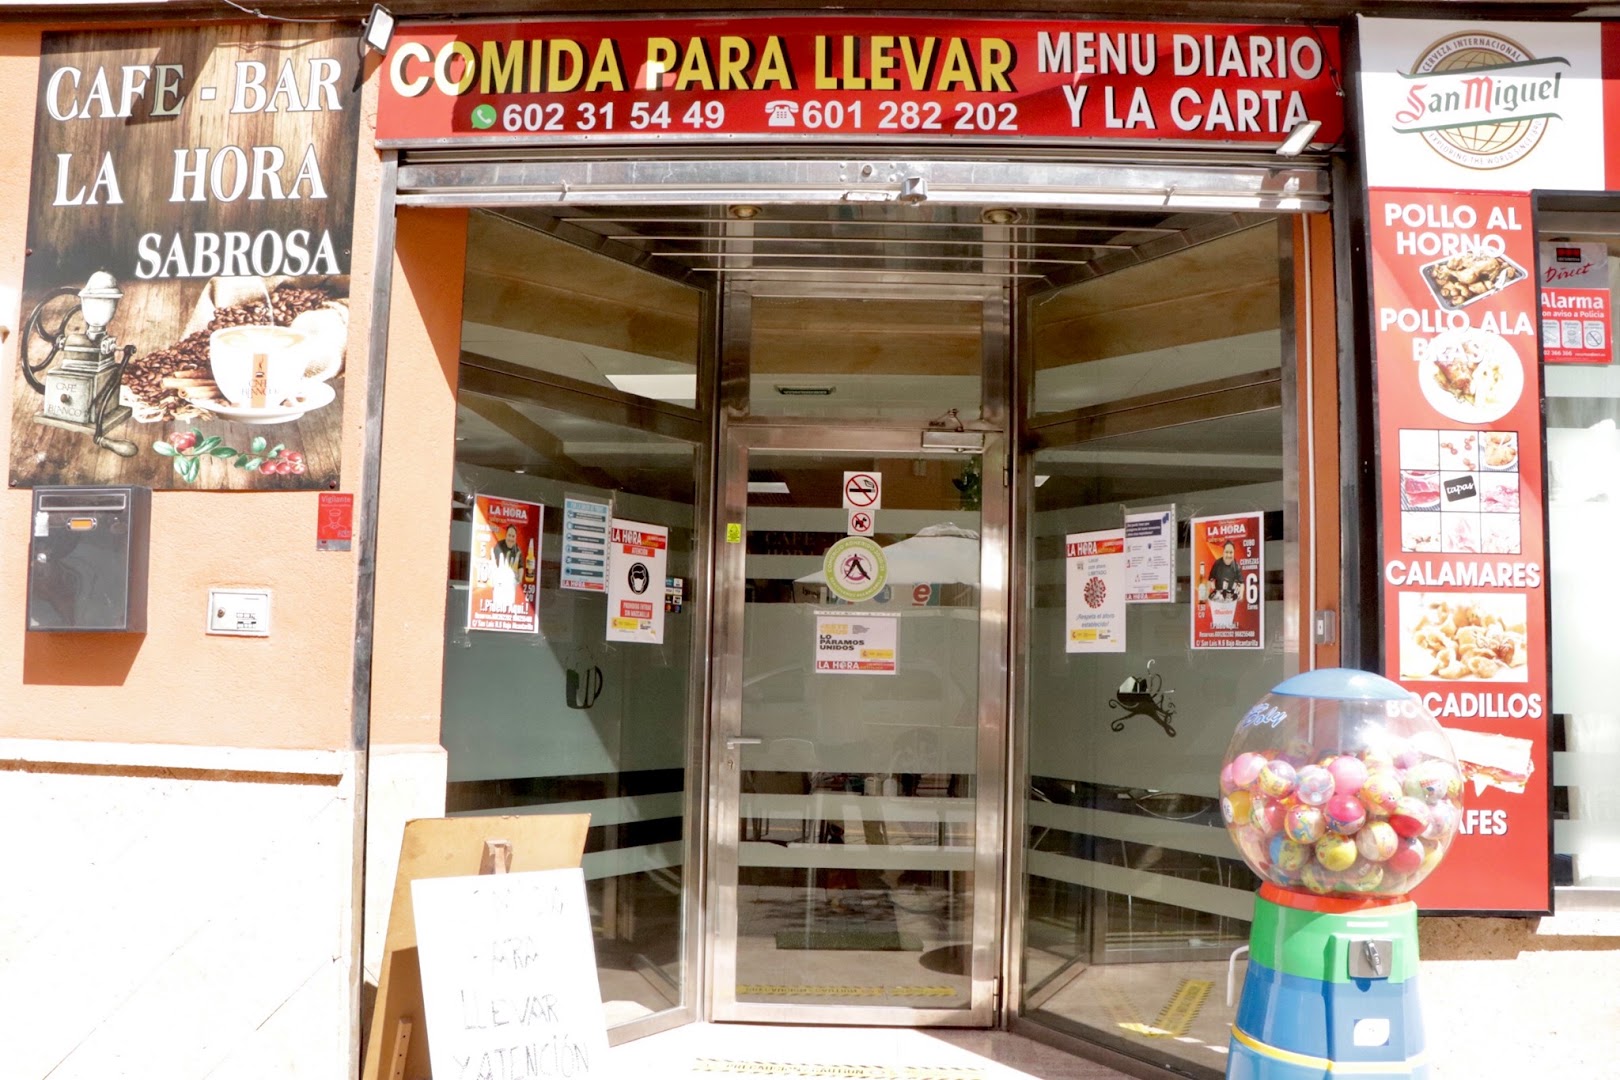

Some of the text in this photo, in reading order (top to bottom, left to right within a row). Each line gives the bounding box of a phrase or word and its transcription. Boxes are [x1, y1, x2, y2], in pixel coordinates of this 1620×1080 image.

[390, 35, 1014, 98] COMIDA PARA LLEVAR
[1037, 31, 1323, 80] MENU DIARIO
[1422, 38, 1522, 72] CERVEZA INTERNACIONAL
[46, 63, 186, 122] CAFE
[230, 57, 343, 114] BAR
[502, 100, 726, 132] 602 31 54 49
[802, 100, 1019, 131] 601 282 202
[1062, 84, 1311, 133] Y LA CARTA
[52, 142, 328, 207] LA HORA
[1384, 203, 1523, 231] POLLO AL
[135, 229, 342, 280] SABROSA
[1396, 231, 1506, 257] HORNO
[1544, 262, 1594, 283] Direct
[1541, 292, 1604, 310] Alarma
[1380, 308, 1534, 336] POLLO ALA
[1446, 481, 1476, 497] tapas
[489, 505, 528, 520] LA HORA
[611, 528, 621, 542] LA
[623, 531, 642, 545] HORA
[1207, 523, 1246, 536] LA HORA
[1066, 543, 1076, 557] LA
[1077, 541, 1098, 556] HORA
[1246, 547, 1252, 558] 5
[1384, 560, 1541, 588] CALAMARES
[1245, 572, 1259, 605] 6
[818, 661, 830, 670] LA
[832, 661, 860, 670] HORA
[1386, 692, 1543, 719] BOCADILLOS
[1457, 809, 1509, 835] AFES
